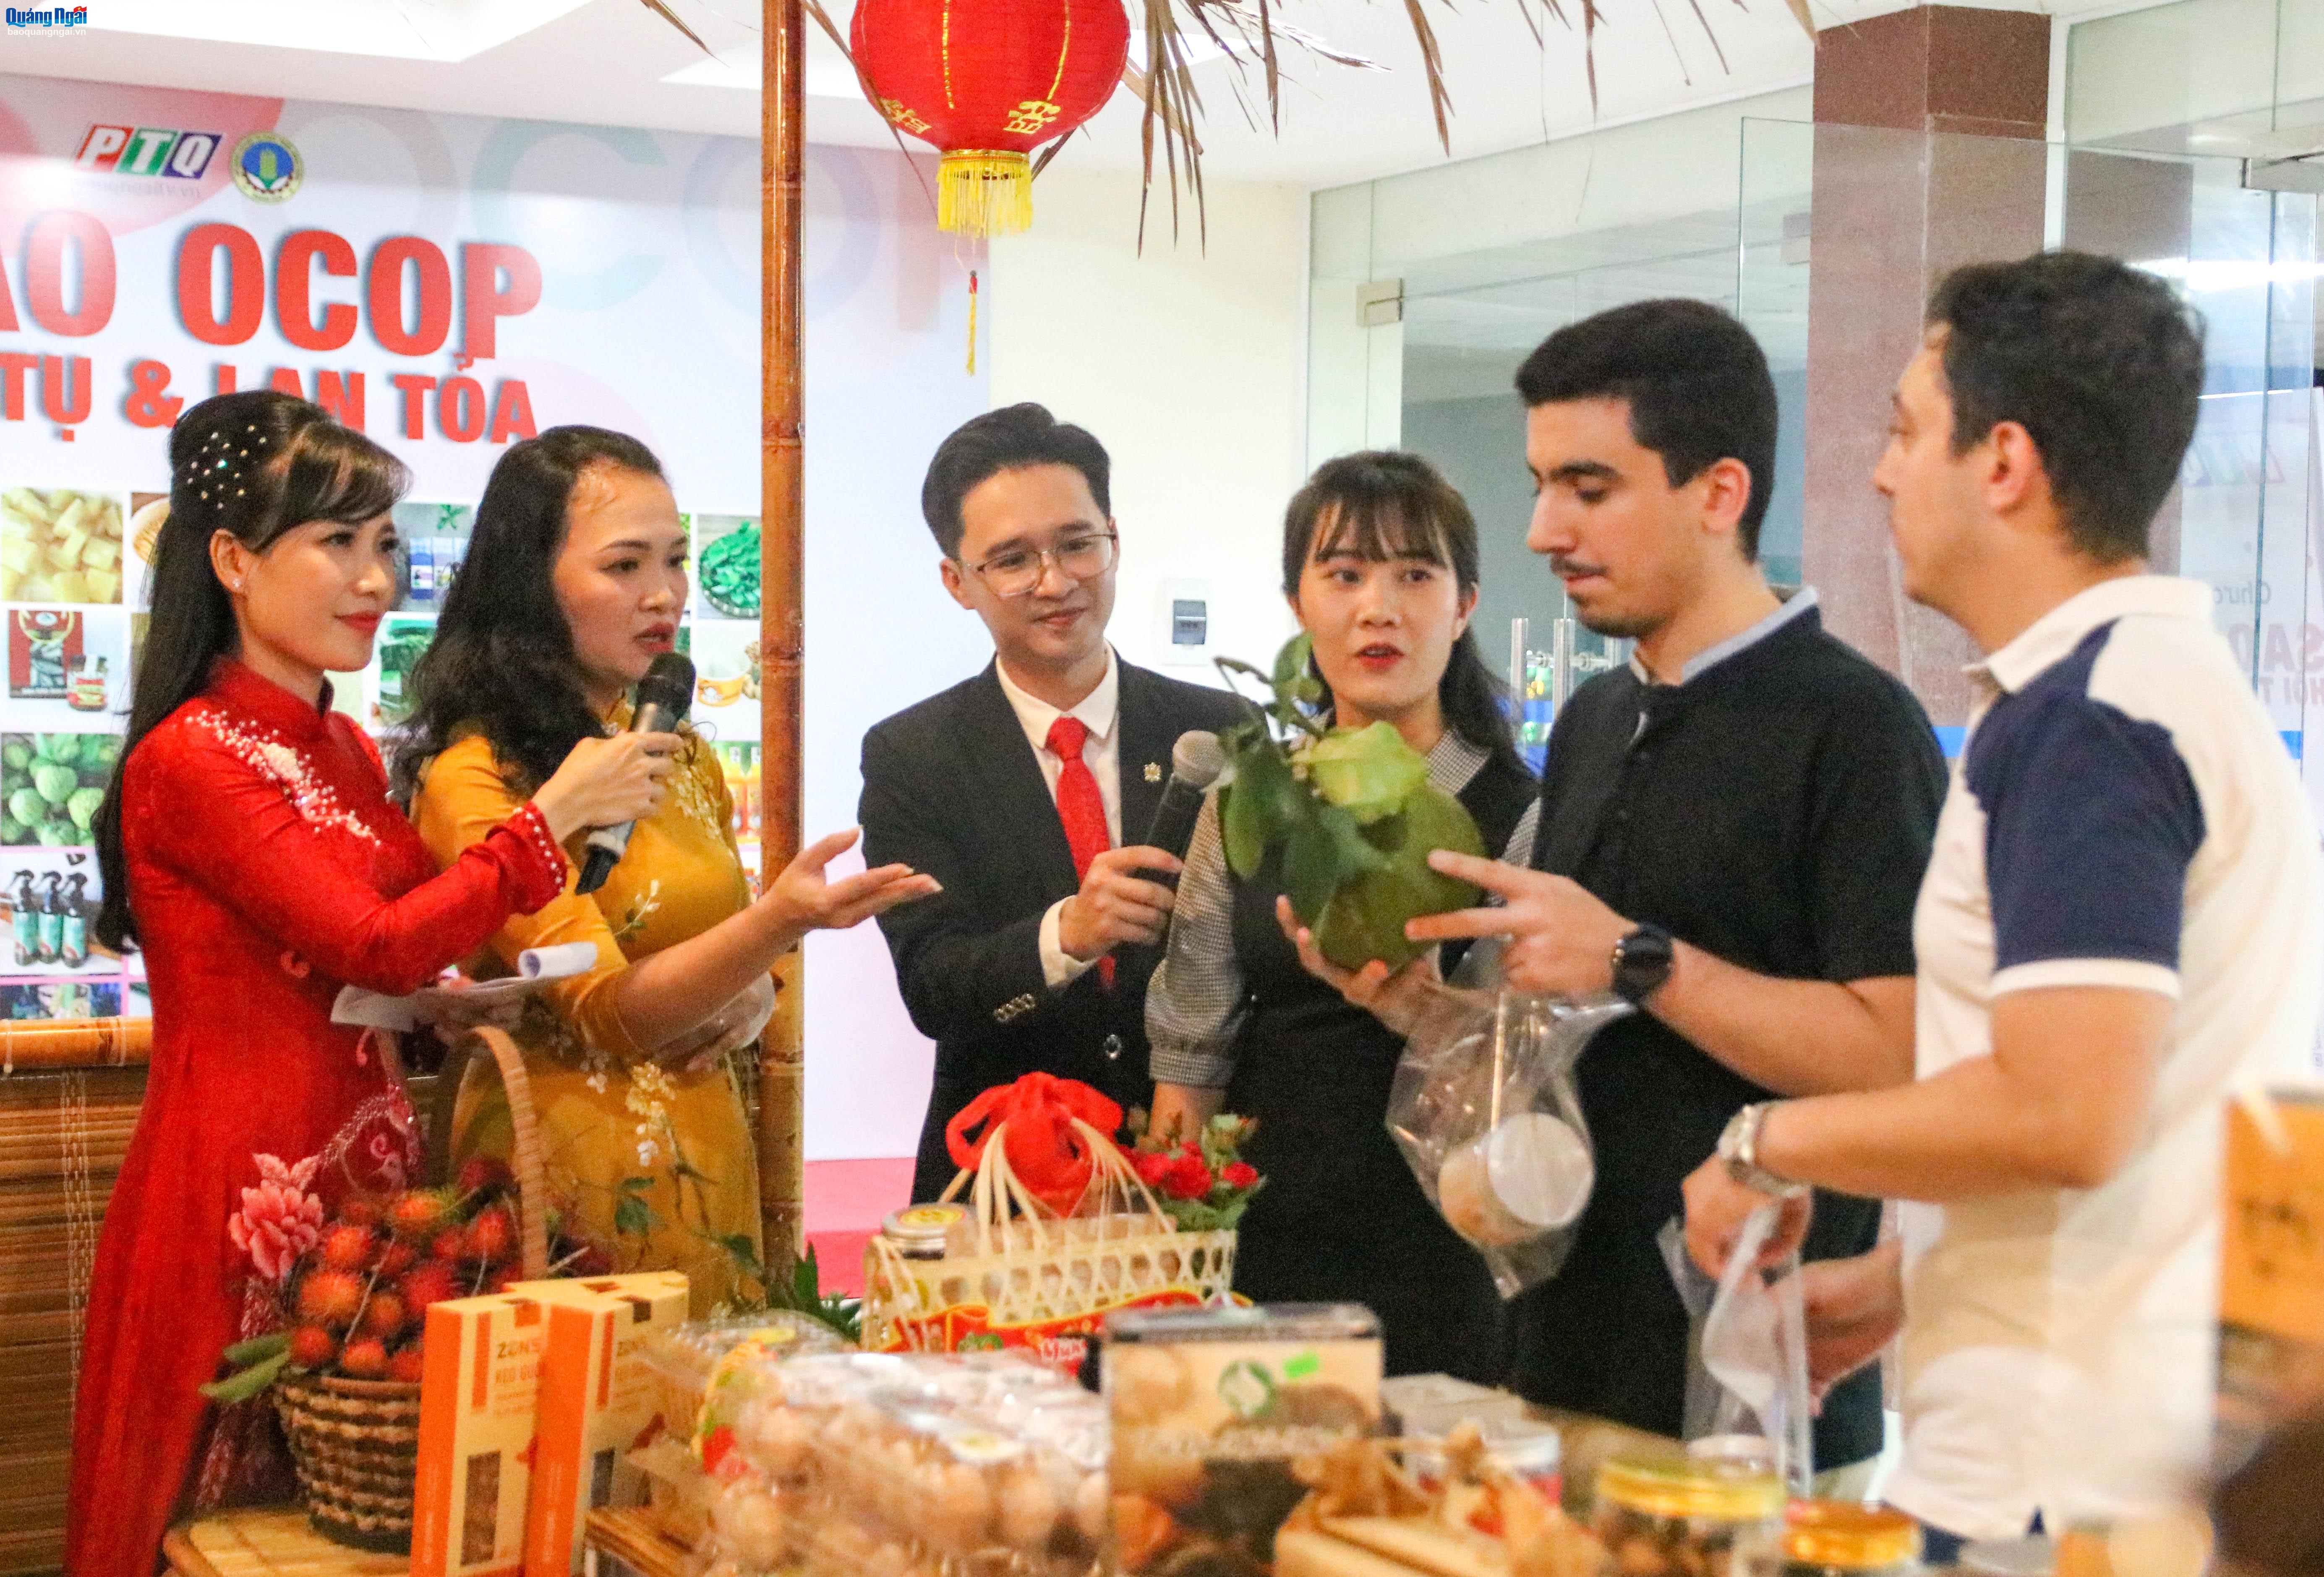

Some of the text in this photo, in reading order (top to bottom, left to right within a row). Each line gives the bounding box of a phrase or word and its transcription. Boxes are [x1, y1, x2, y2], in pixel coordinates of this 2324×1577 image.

[76, 125, 223, 179] PTQ
[178, 223, 542, 359] OCOP
[0, 352, 91, 442] TỤ
[127, 360, 184, 428] &
